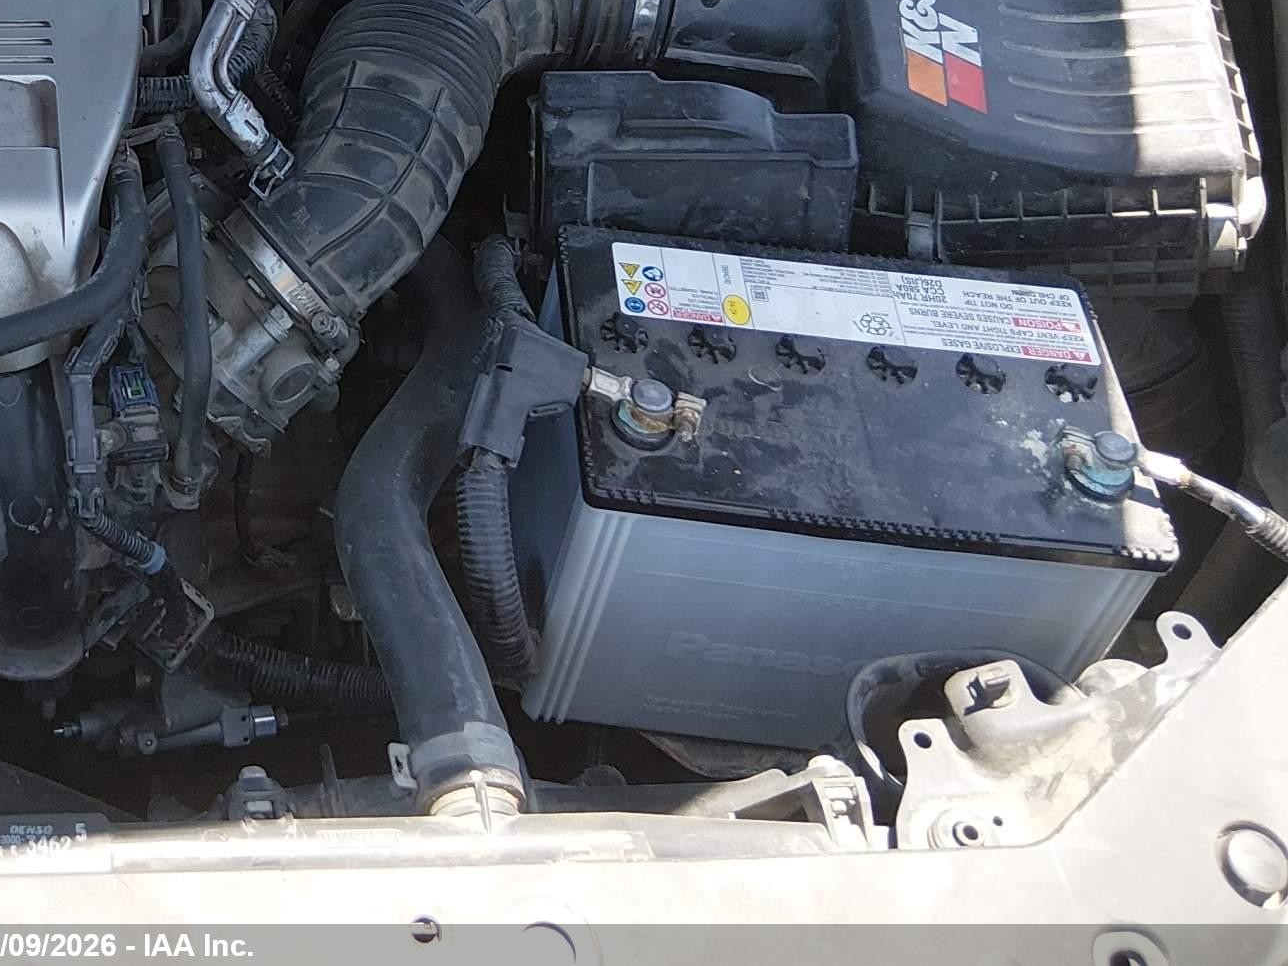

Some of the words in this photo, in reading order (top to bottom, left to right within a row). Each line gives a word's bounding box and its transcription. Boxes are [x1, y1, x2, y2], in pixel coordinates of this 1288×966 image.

[895, 283, 919, 292] 580A
[922, 286, 945, 295] CCA
[892, 291, 918, 300] 70Ah
[921, 293, 947, 303] 20HR
[963, 291, 993, 299] REACH
[1048, 299, 1071, 307] KEEP
[909, 307, 937, 317] BURNS
[940, 310, 975, 321] SEVERE
[976, 314, 1010, 325] CAUSES
[1018, 318, 1061, 330] POISON
[930, 320, 958, 329] LEVEL
[960, 323, 979, 331] AND
[982, 325, 1007, 334] TIGHT
[1010, 329, 1034, 337] CAPS
[1036, 331, 1059, 339] VENT
[1061, 334, 1083, 342] KEEP
[941, 338, 970, 348] GASES
[972, 341, 1020, 354] EXPLOSIVE
[1028, 347, 1072, 358] DANGER
[10, 825, 53, 834] DENSO
[75, 823, 87, 842] 5
